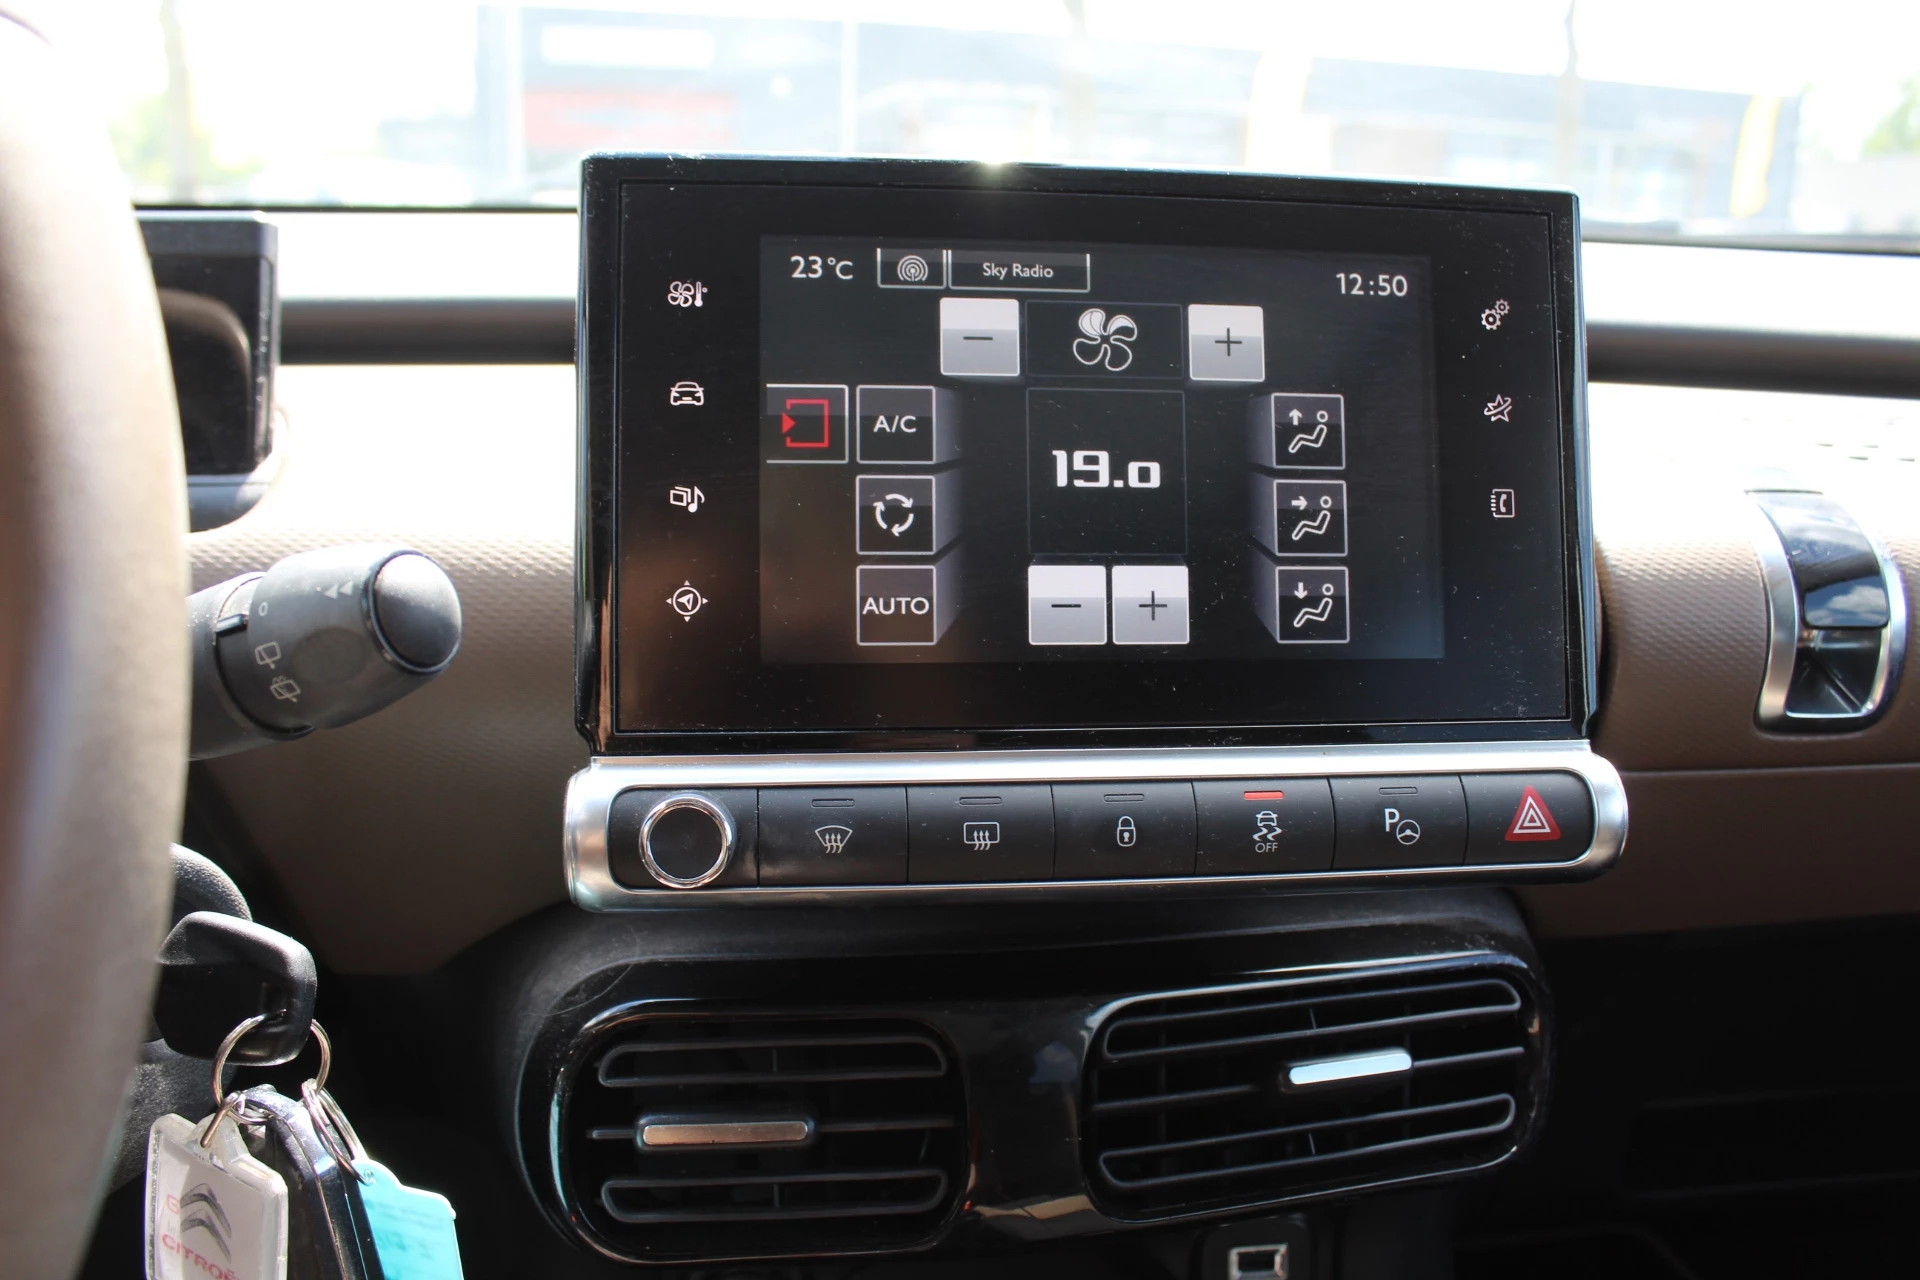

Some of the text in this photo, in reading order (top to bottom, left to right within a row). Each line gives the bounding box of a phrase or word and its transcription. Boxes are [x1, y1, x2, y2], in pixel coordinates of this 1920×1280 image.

[982, 262, 1054, 281] Sky Radio
[1335, 272, 1409, 298] 12:50
[873, 414, 917, 433] A/C
[862, 596, 930, 615] AUTO
[1384, 808, 1399, 832] P
[1254, 842, 1279, 853] OFF
